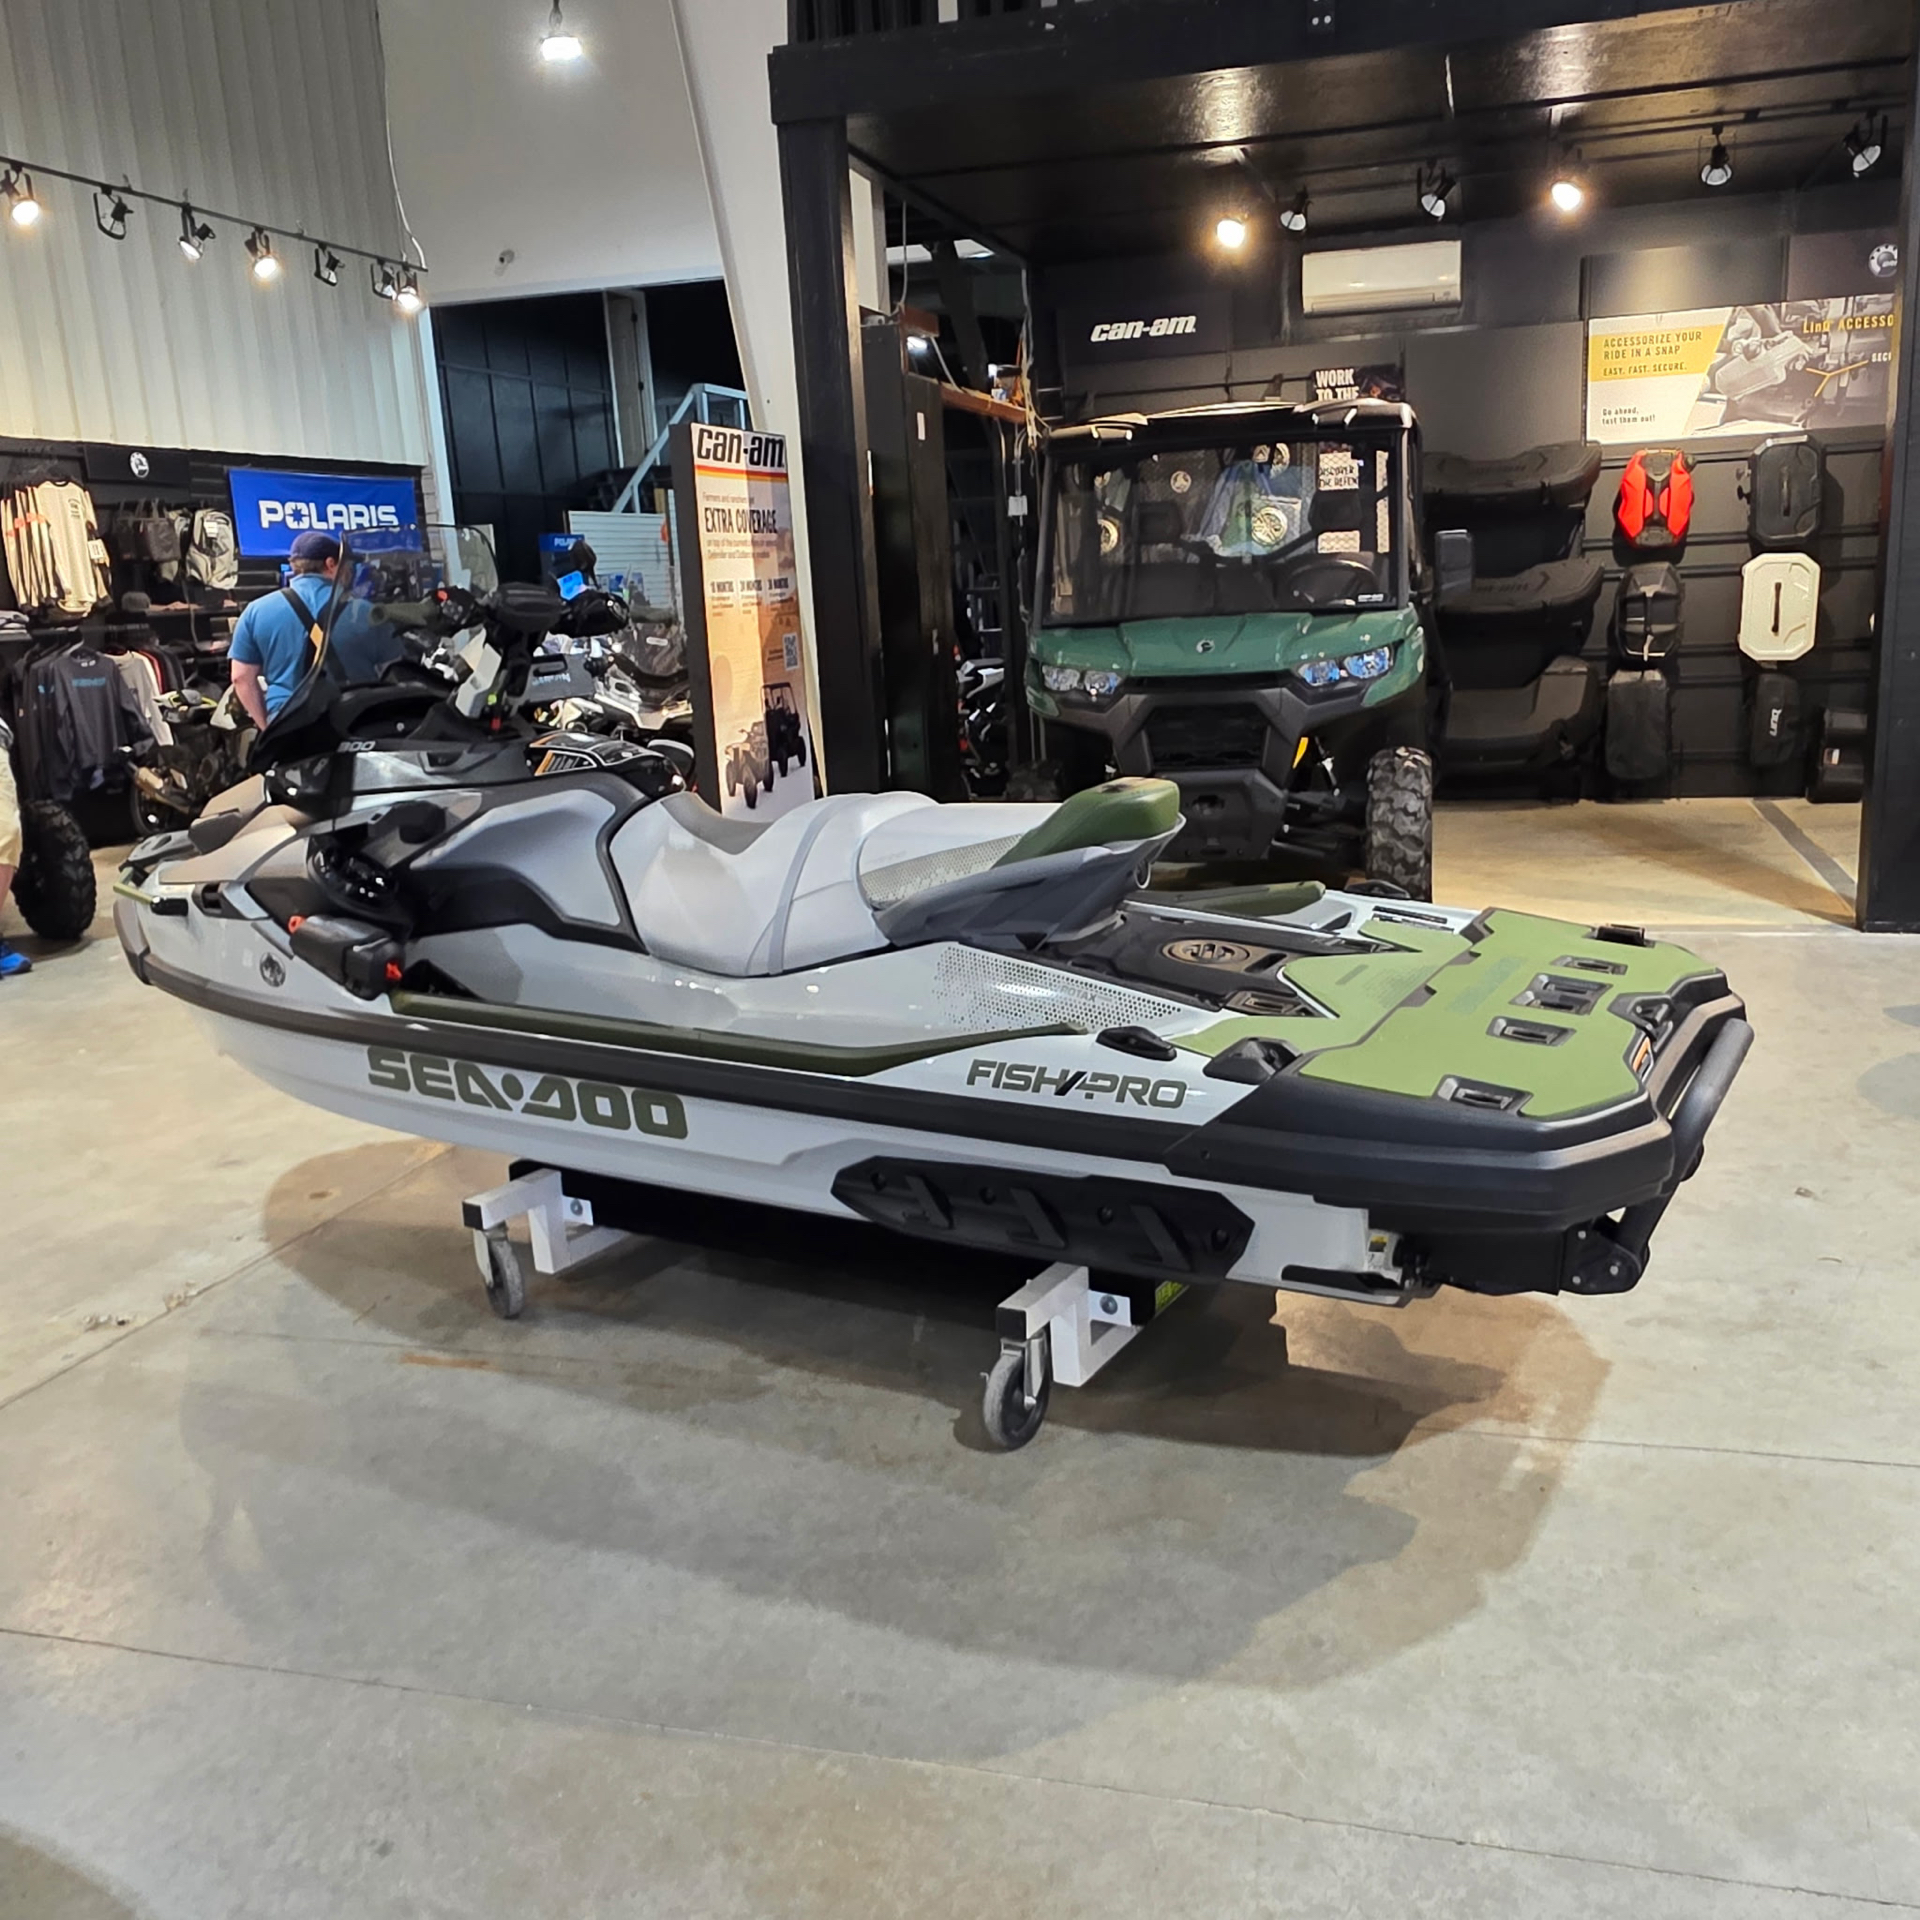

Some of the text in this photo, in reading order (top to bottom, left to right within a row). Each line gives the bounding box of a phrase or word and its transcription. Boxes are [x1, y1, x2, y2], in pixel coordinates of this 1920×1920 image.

[1090, 315, 1196, 342] can-am
[1603, 331, 1702, 348] ACCESSORIZE YOUR
[1603, 345, 1681, 360] RIDE IN A SNAP
[1315, 368, 1355, 388] WORK
[1603, 362, 1687, 376] EASY. FAST. SECURE.
[1315, 388, 1333, 401] TO
[697, 427, 785, 468] can-am
[258, 500, 400, 531] POLARIS
[704, 507, 778, 534] EXTRA COVERAGE
